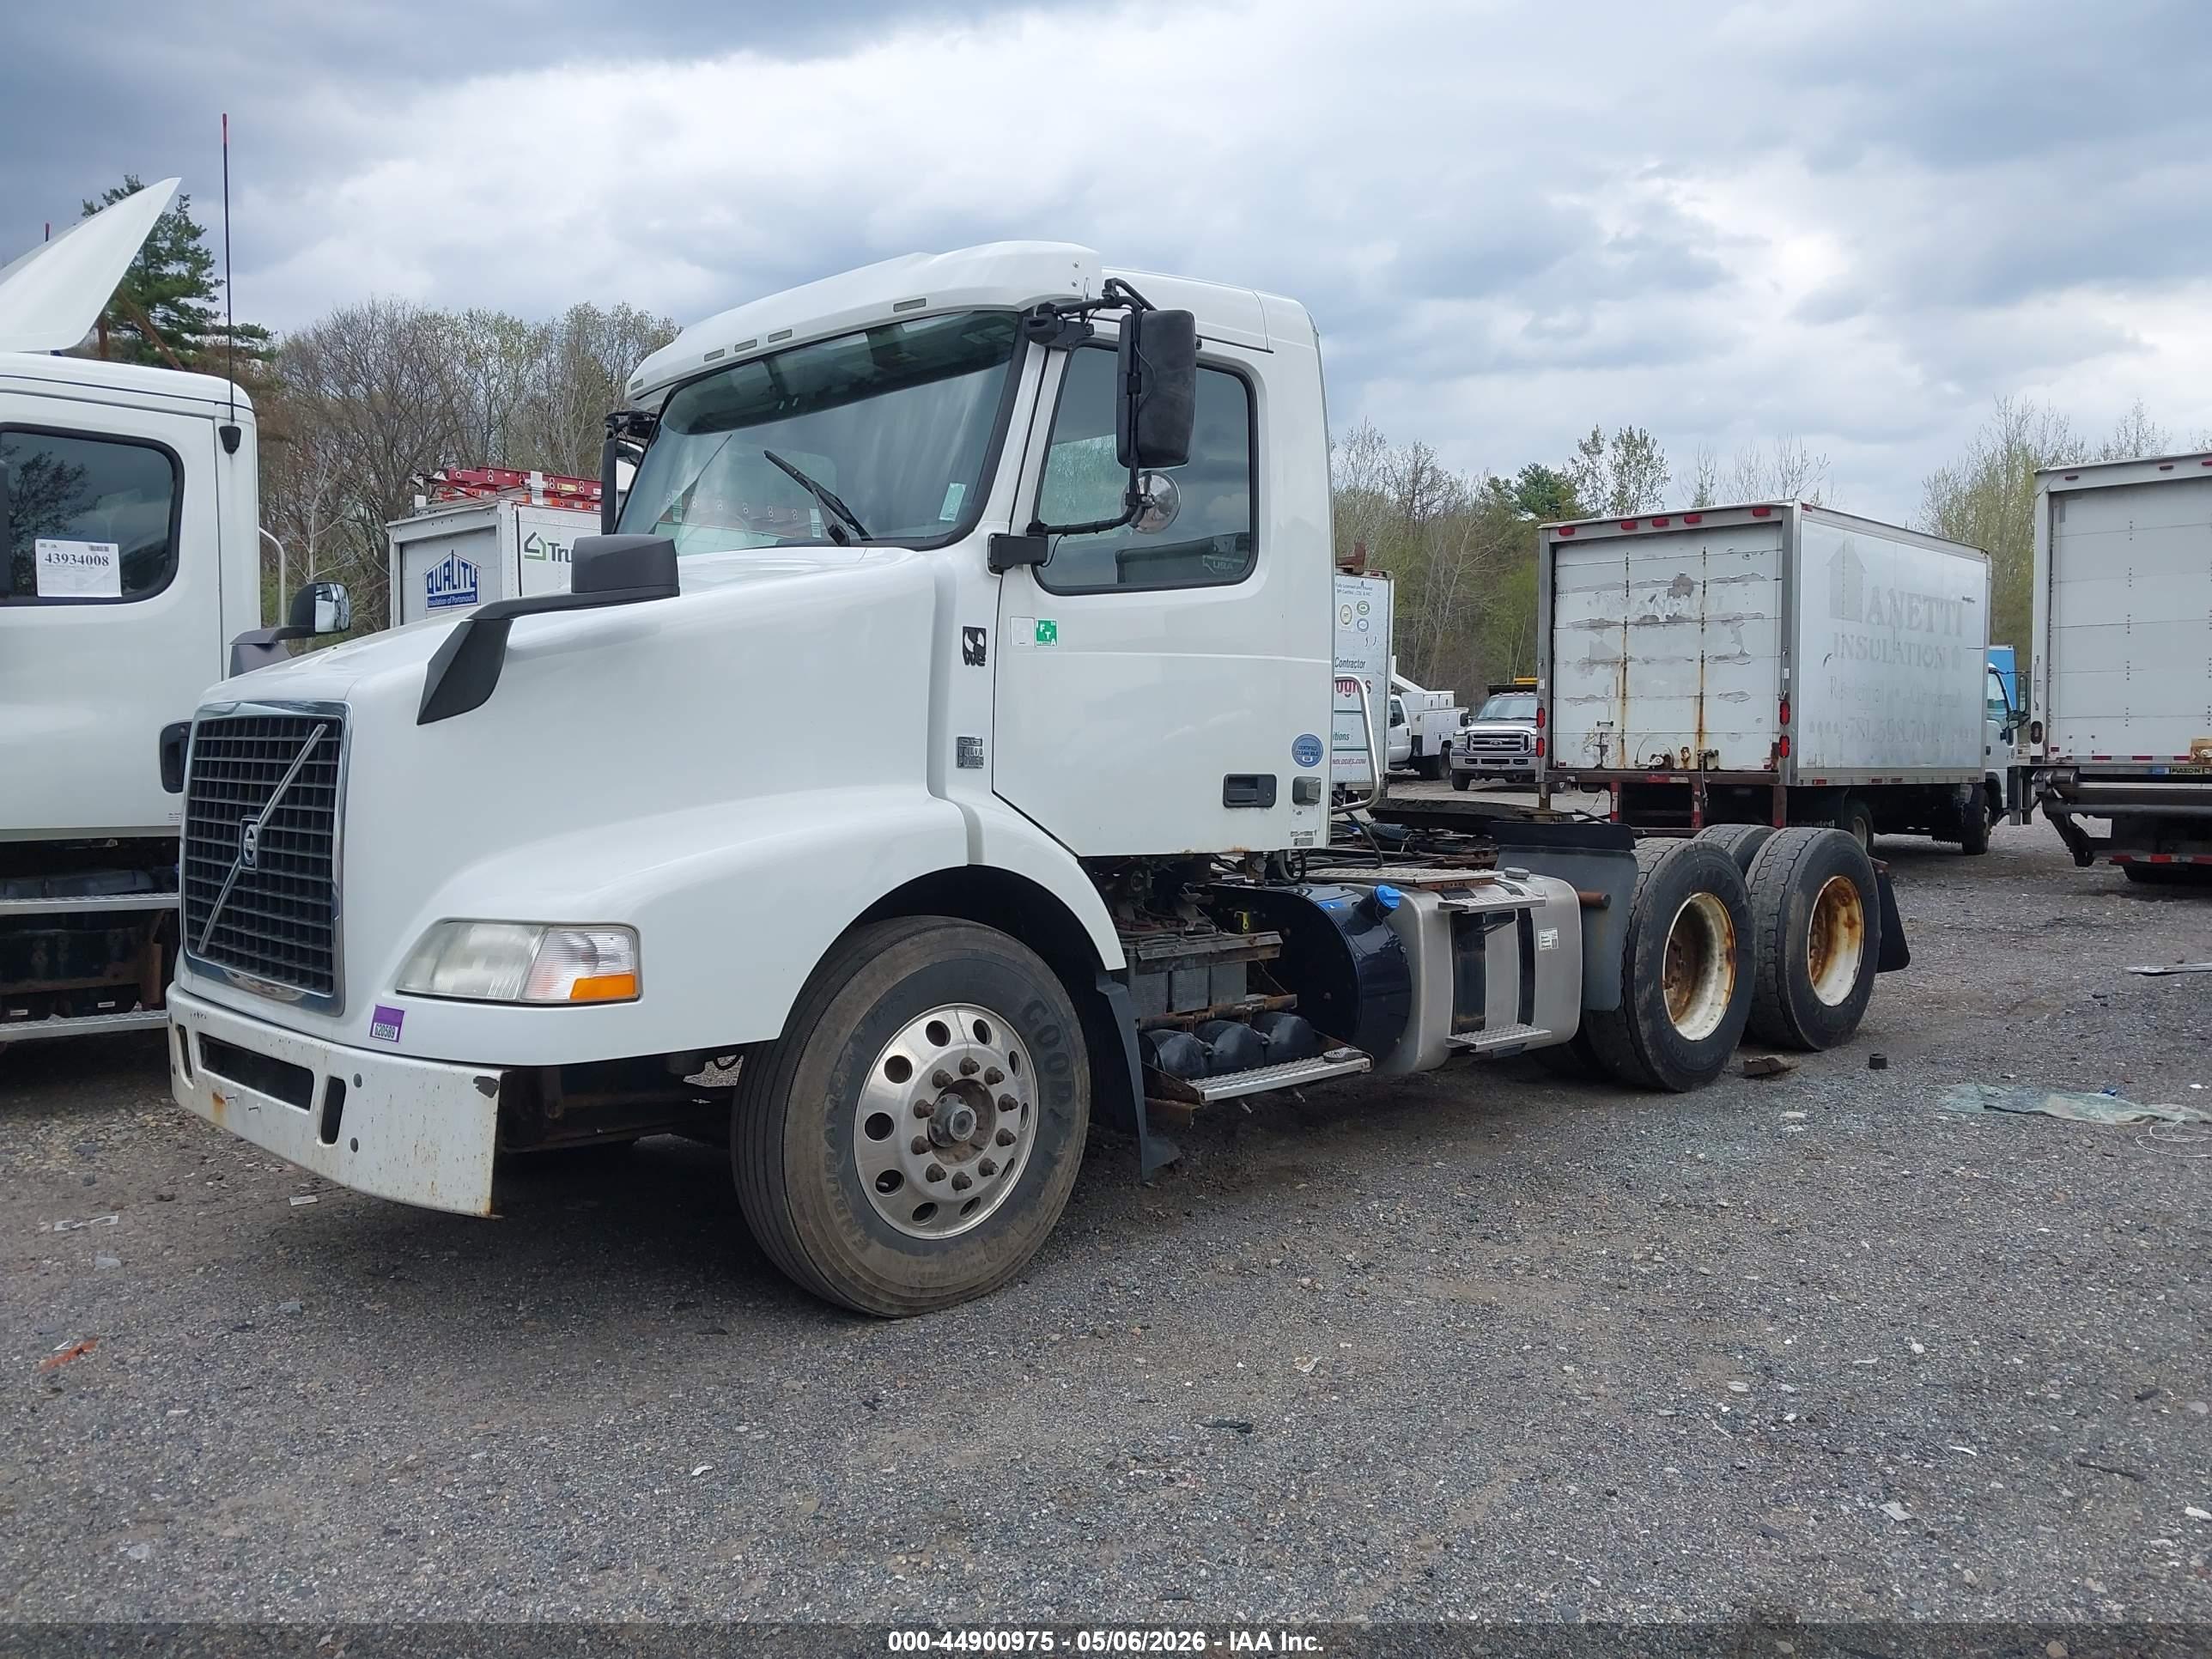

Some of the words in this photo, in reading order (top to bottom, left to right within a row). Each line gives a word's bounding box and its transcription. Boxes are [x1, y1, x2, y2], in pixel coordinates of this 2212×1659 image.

[45, 552, 109, 567] 43934008
[427, 554, 477, 594] QUALITY
[1832, 632, 1947, 671] INSULATION
[1334, 656, 1366, 669] Contractor
[958, 746, 983, 757] VOLVO
[374, 1024, 396, 1039] 620589
